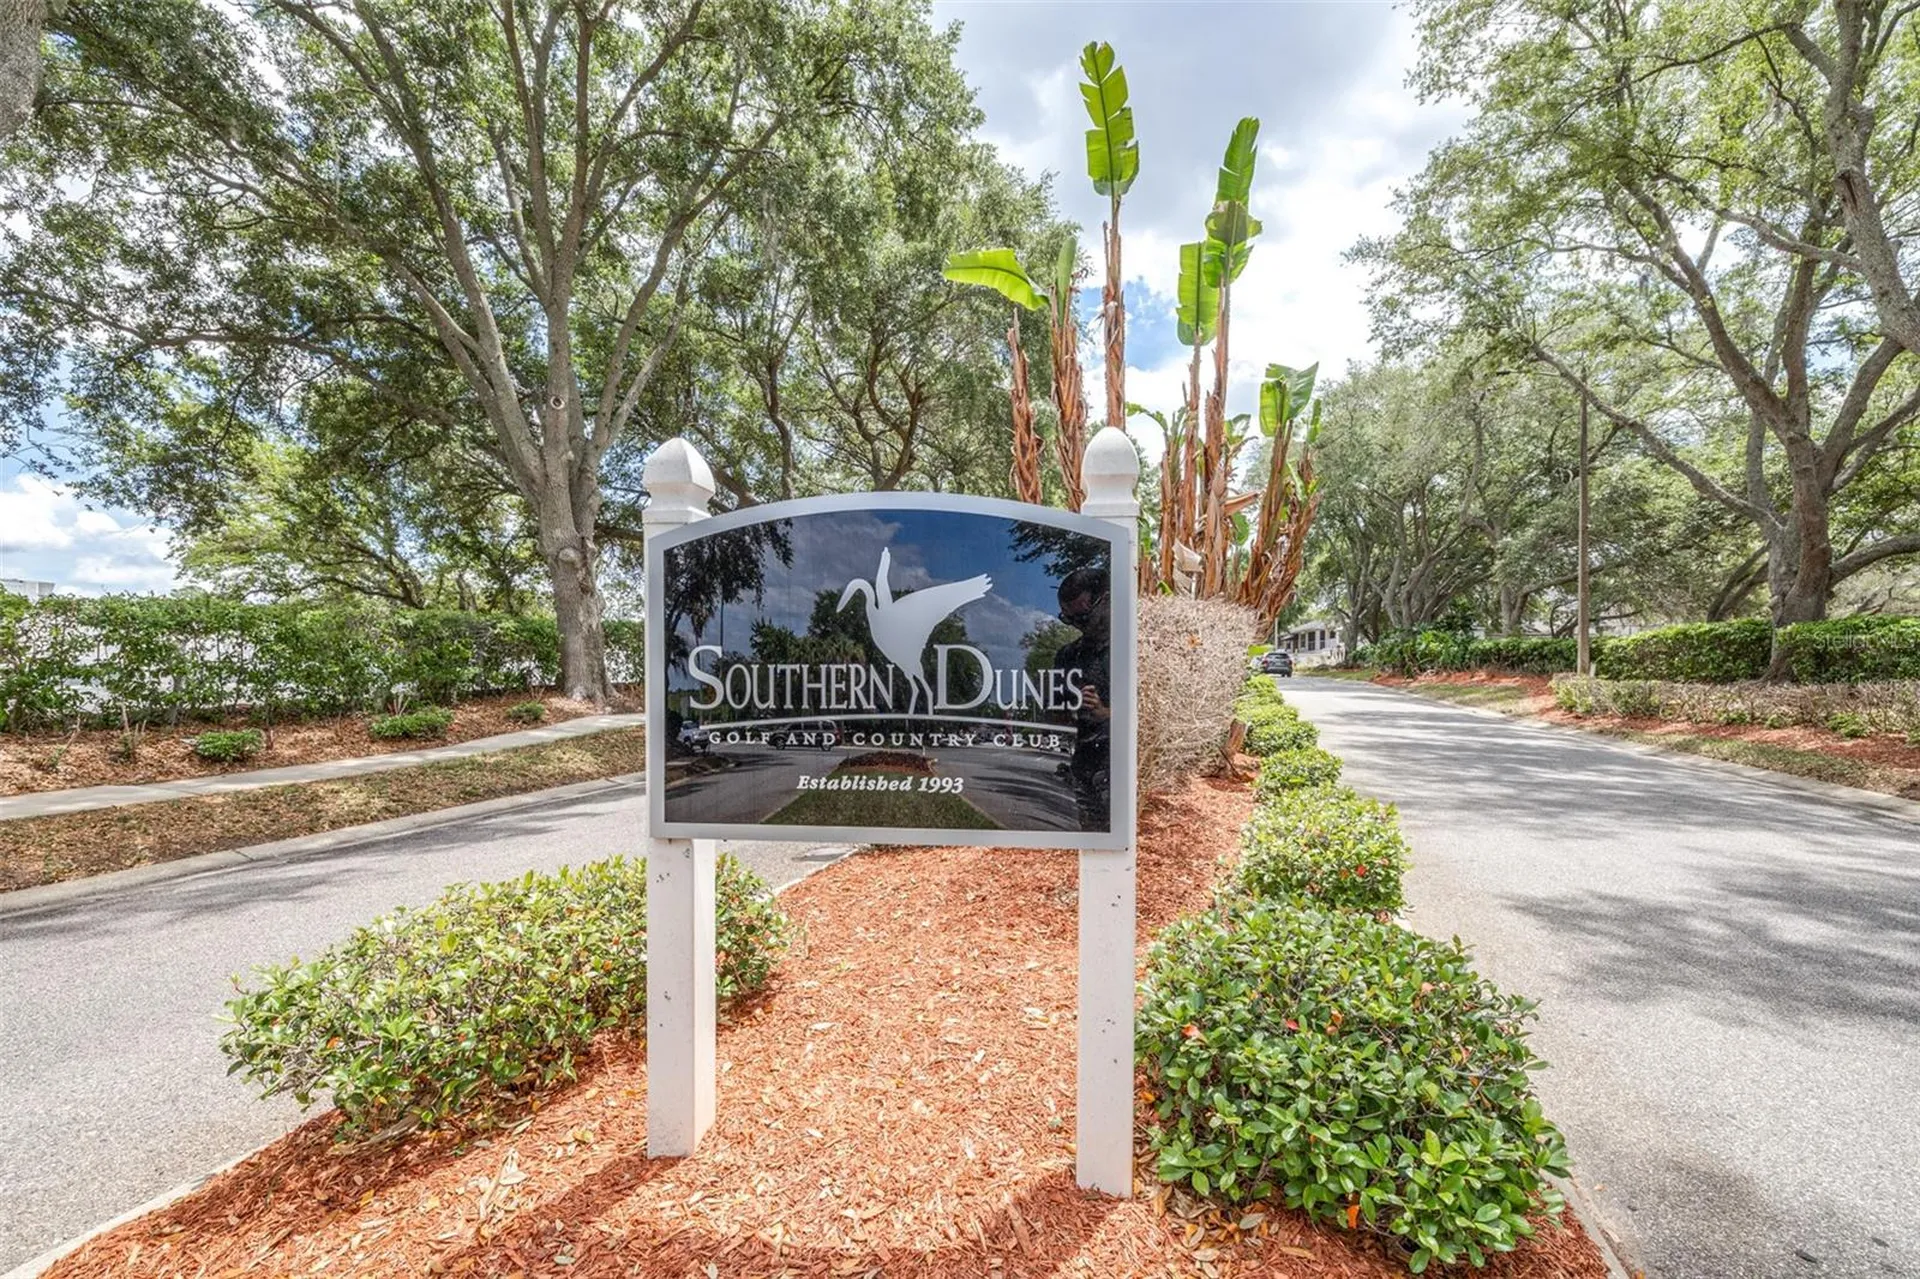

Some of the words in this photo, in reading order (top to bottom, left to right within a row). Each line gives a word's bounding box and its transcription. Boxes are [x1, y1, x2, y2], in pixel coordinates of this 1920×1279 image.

[709, 731, 770, 745] GOLF
[786, 732, 836, 746] AND
[852, 732, 976, 747] COUNTRY
[993, 734, 1060, 748] CLUB
[796, 775, 912, 792] Established
[917, 776, 964, 794] 1993
